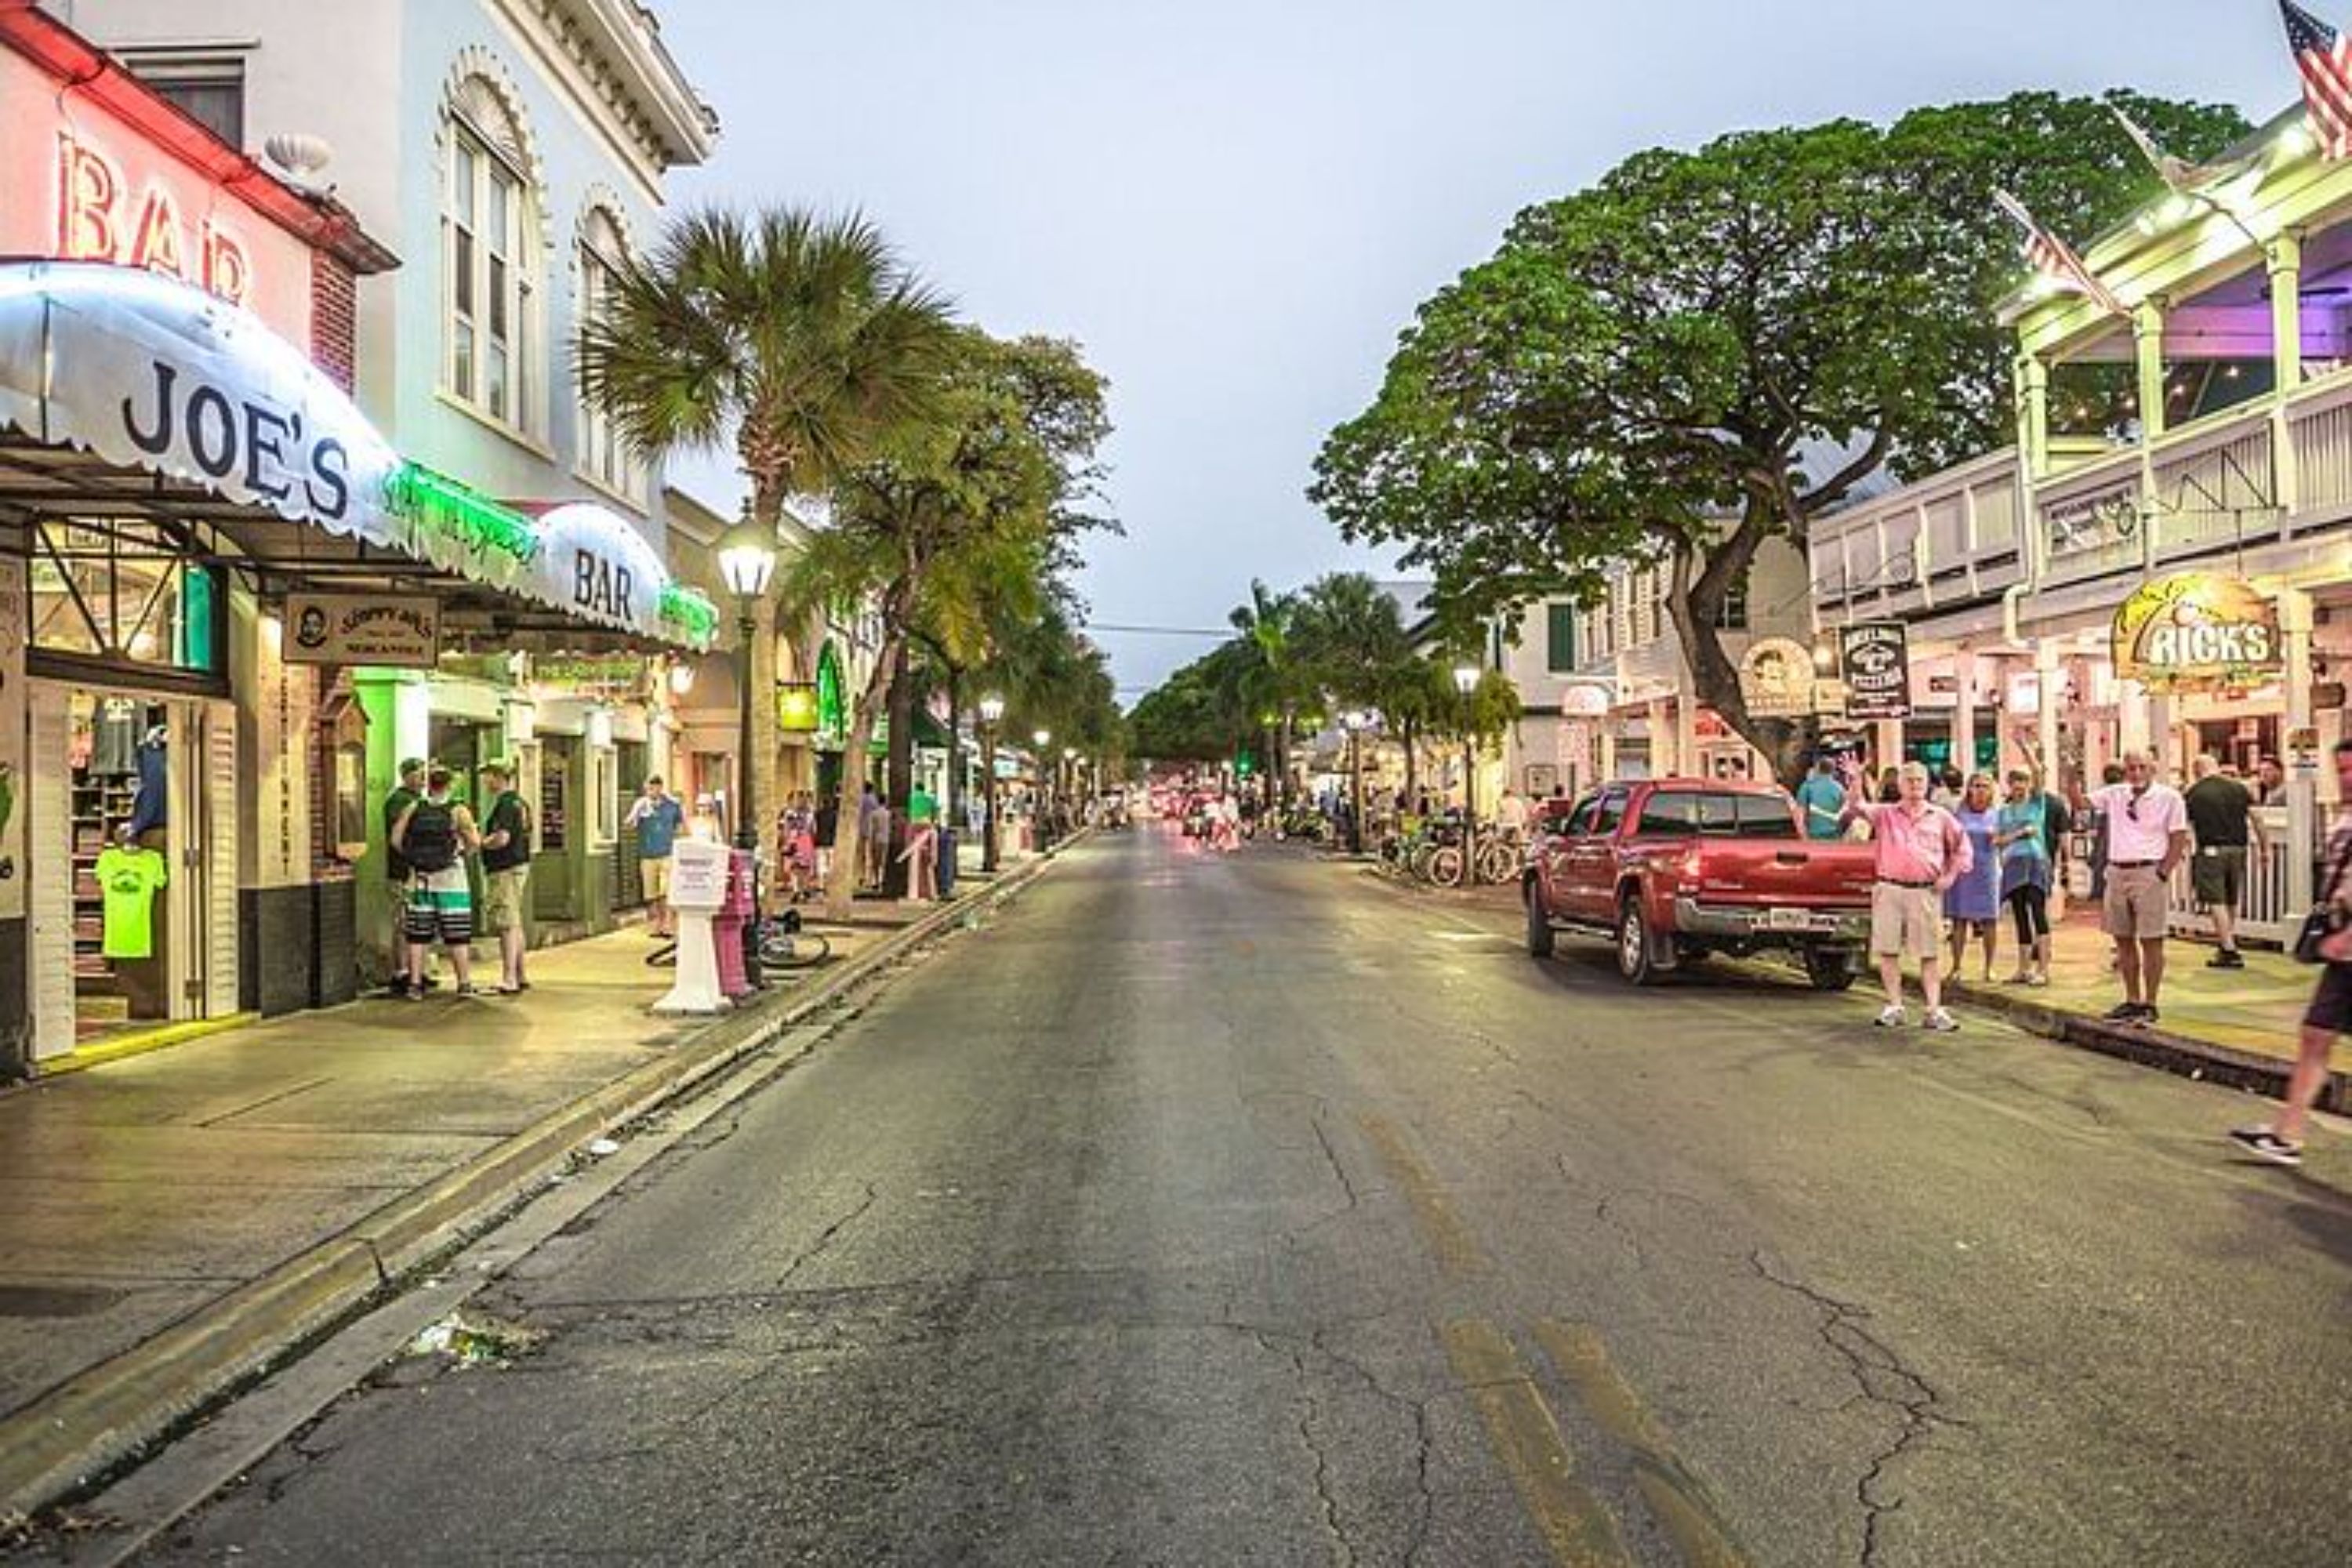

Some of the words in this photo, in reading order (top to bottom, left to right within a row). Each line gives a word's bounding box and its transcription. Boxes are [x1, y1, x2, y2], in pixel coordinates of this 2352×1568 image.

[56, 129, 249, 307] BAR
[122, 361, 350, 522] JOE'S
[574, 547, 633, 622] BAR
[2148, 622, 2270, 666] RICK'S
